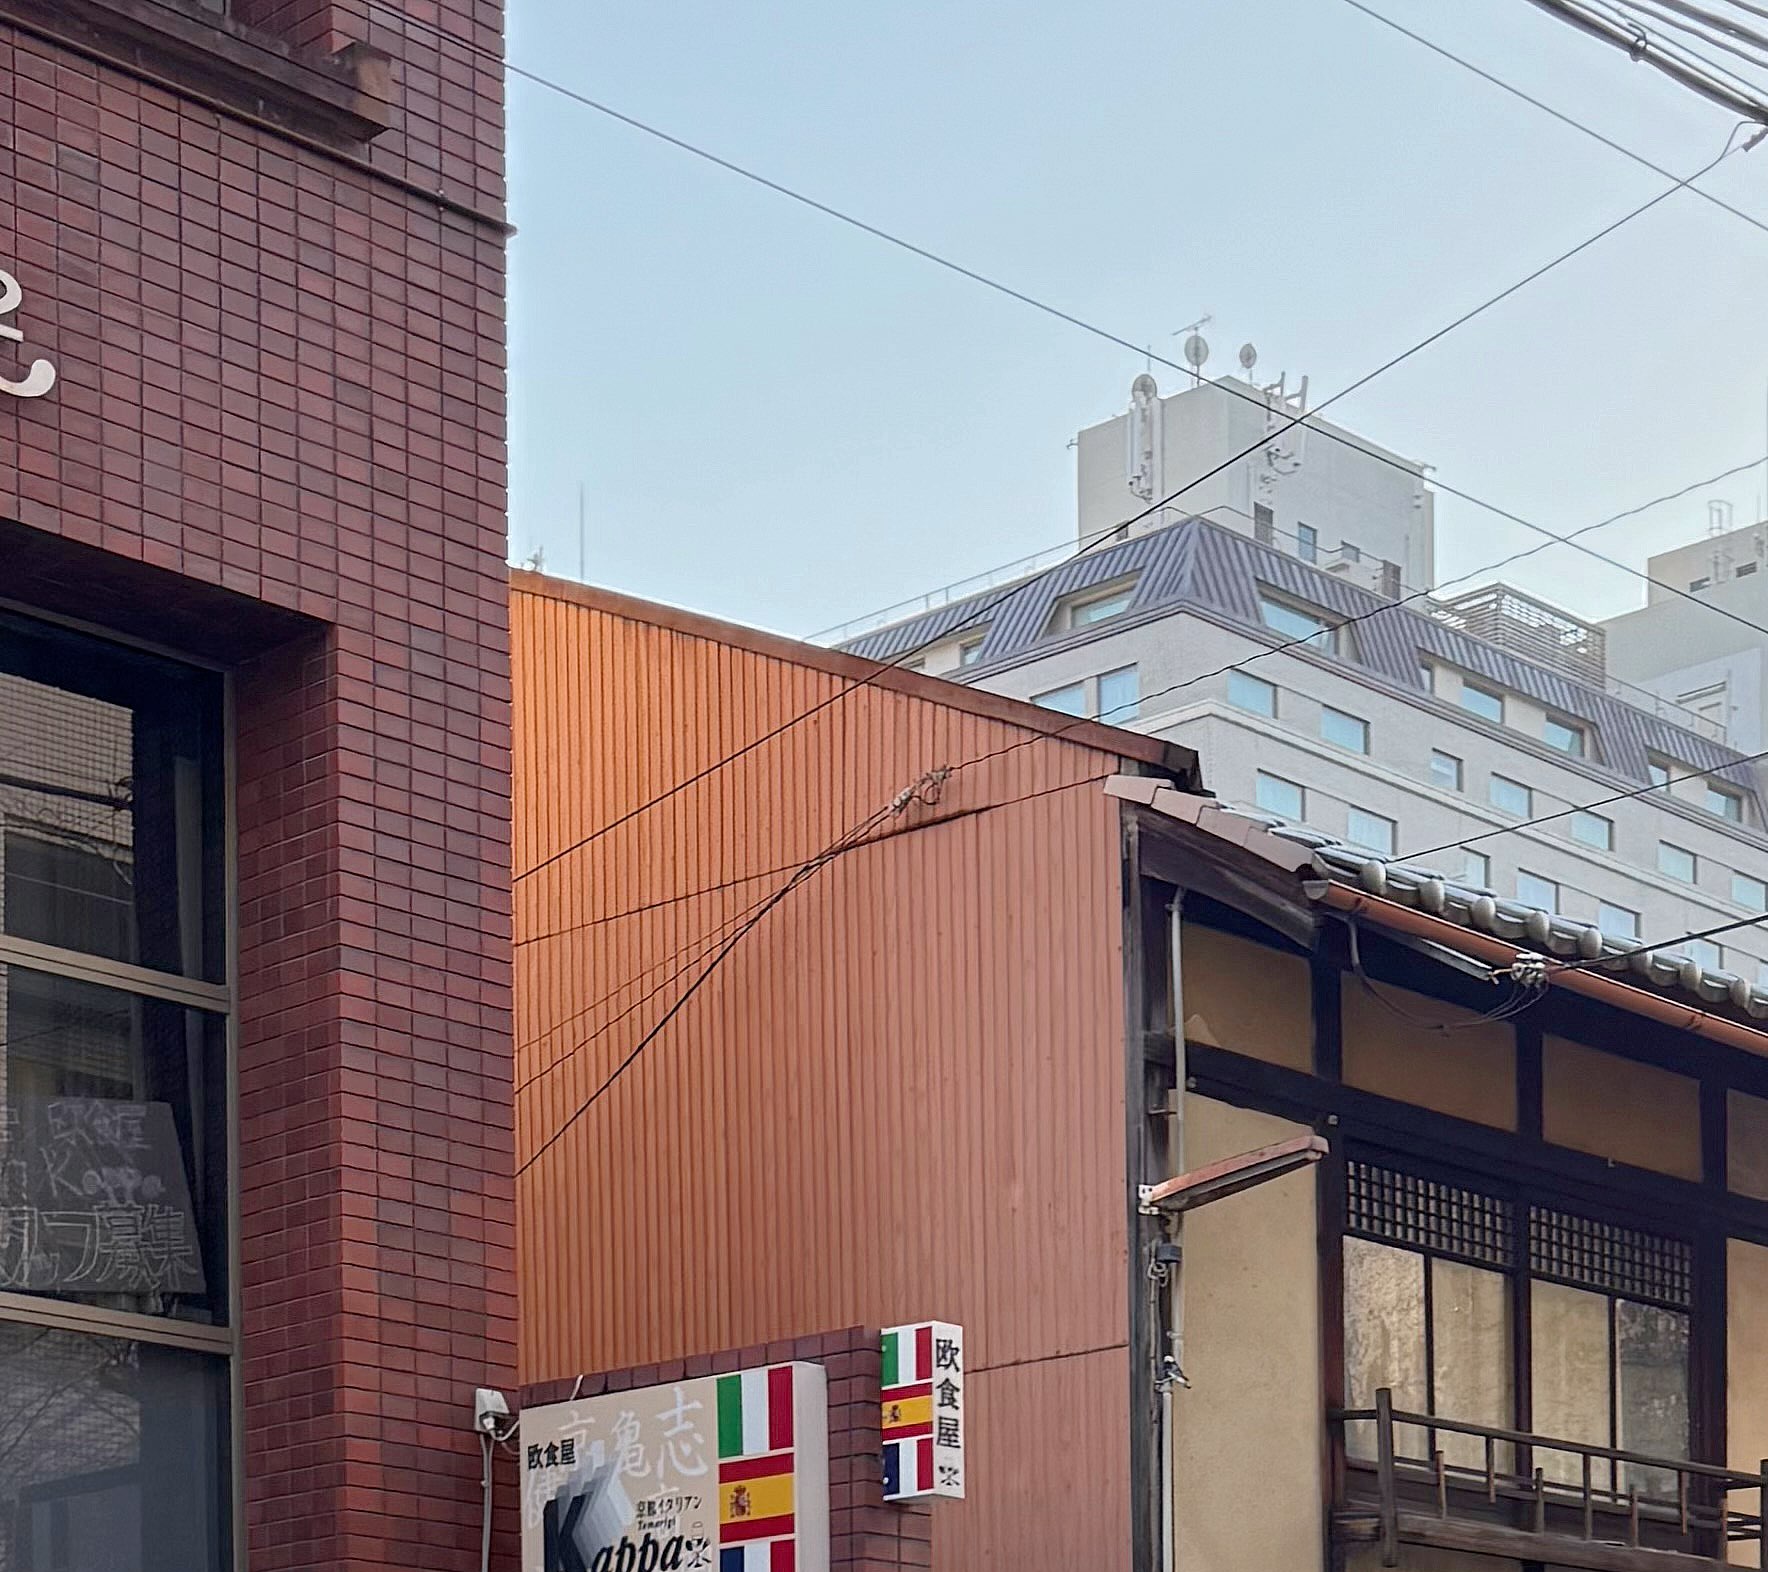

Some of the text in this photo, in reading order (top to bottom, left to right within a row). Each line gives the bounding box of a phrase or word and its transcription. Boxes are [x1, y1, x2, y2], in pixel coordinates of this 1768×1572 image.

[935, 1338, 961, 1449] 欧食屋
[527, 1437, 576, 1471] 欧食屋
